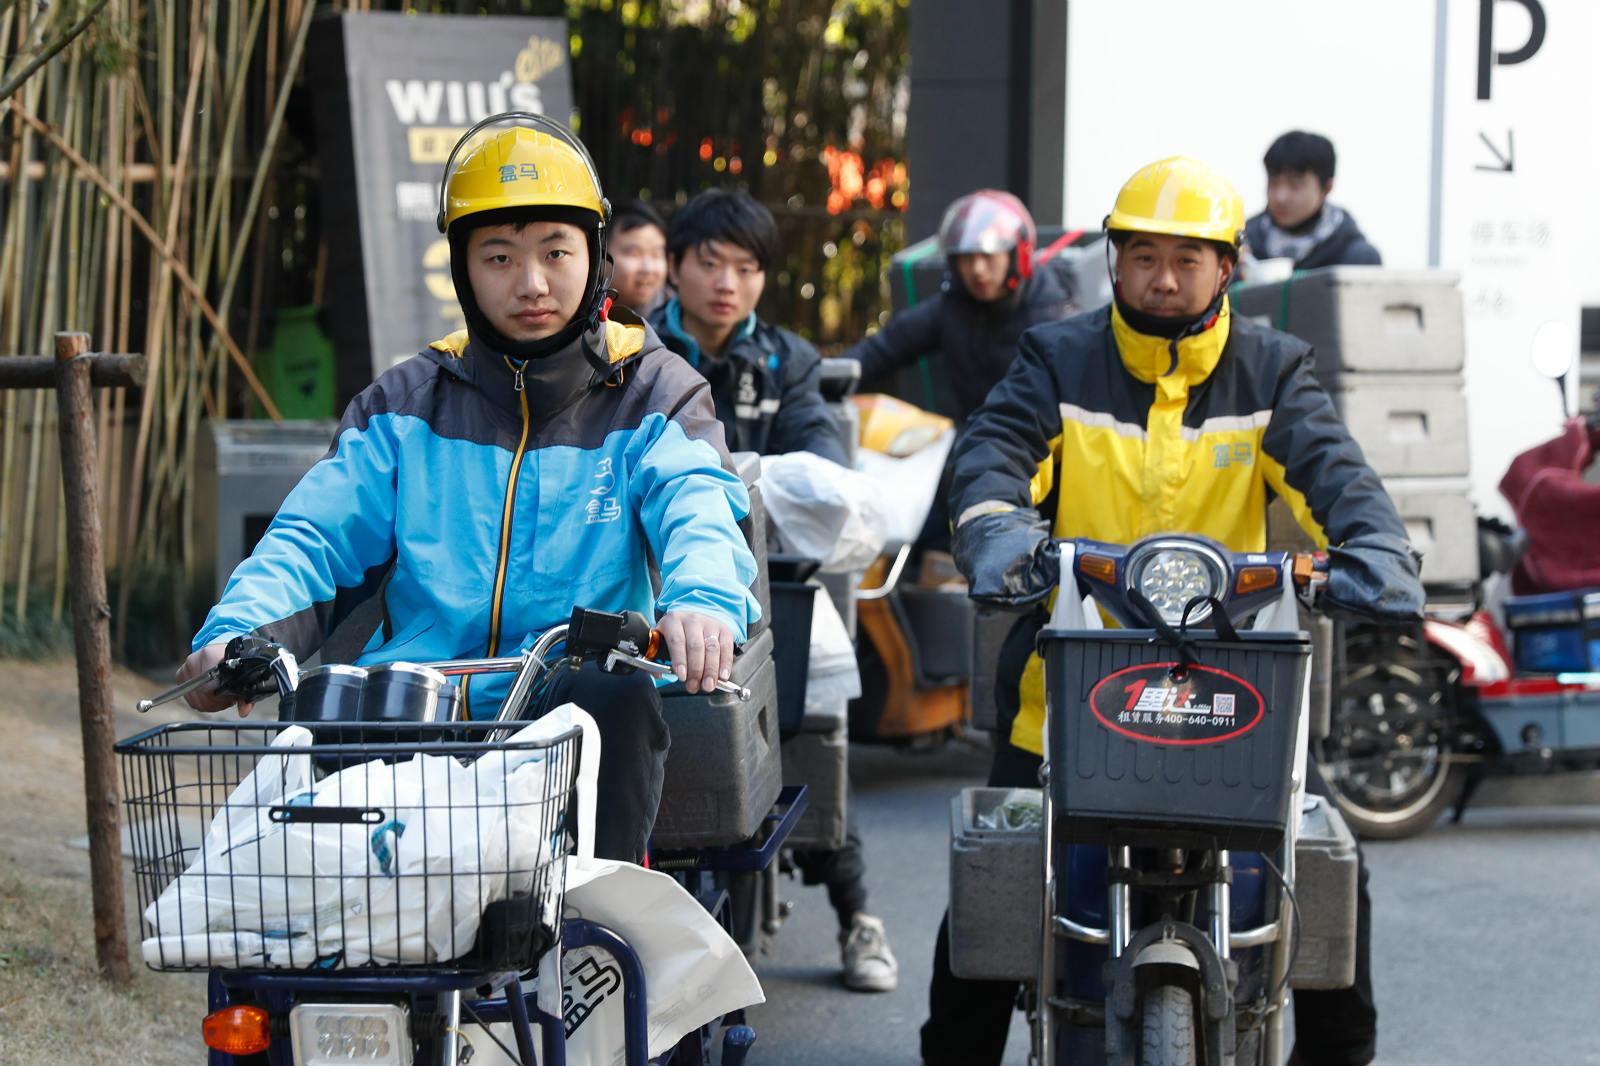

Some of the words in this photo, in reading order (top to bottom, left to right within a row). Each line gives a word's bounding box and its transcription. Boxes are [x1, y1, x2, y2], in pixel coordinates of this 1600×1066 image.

[1477, 0, 1546, 101] P
[498, 163, 539, 183] 盒马
[1213, 442, 1254, 468] 盒马
[585, 497, 621, 525] 盒马
